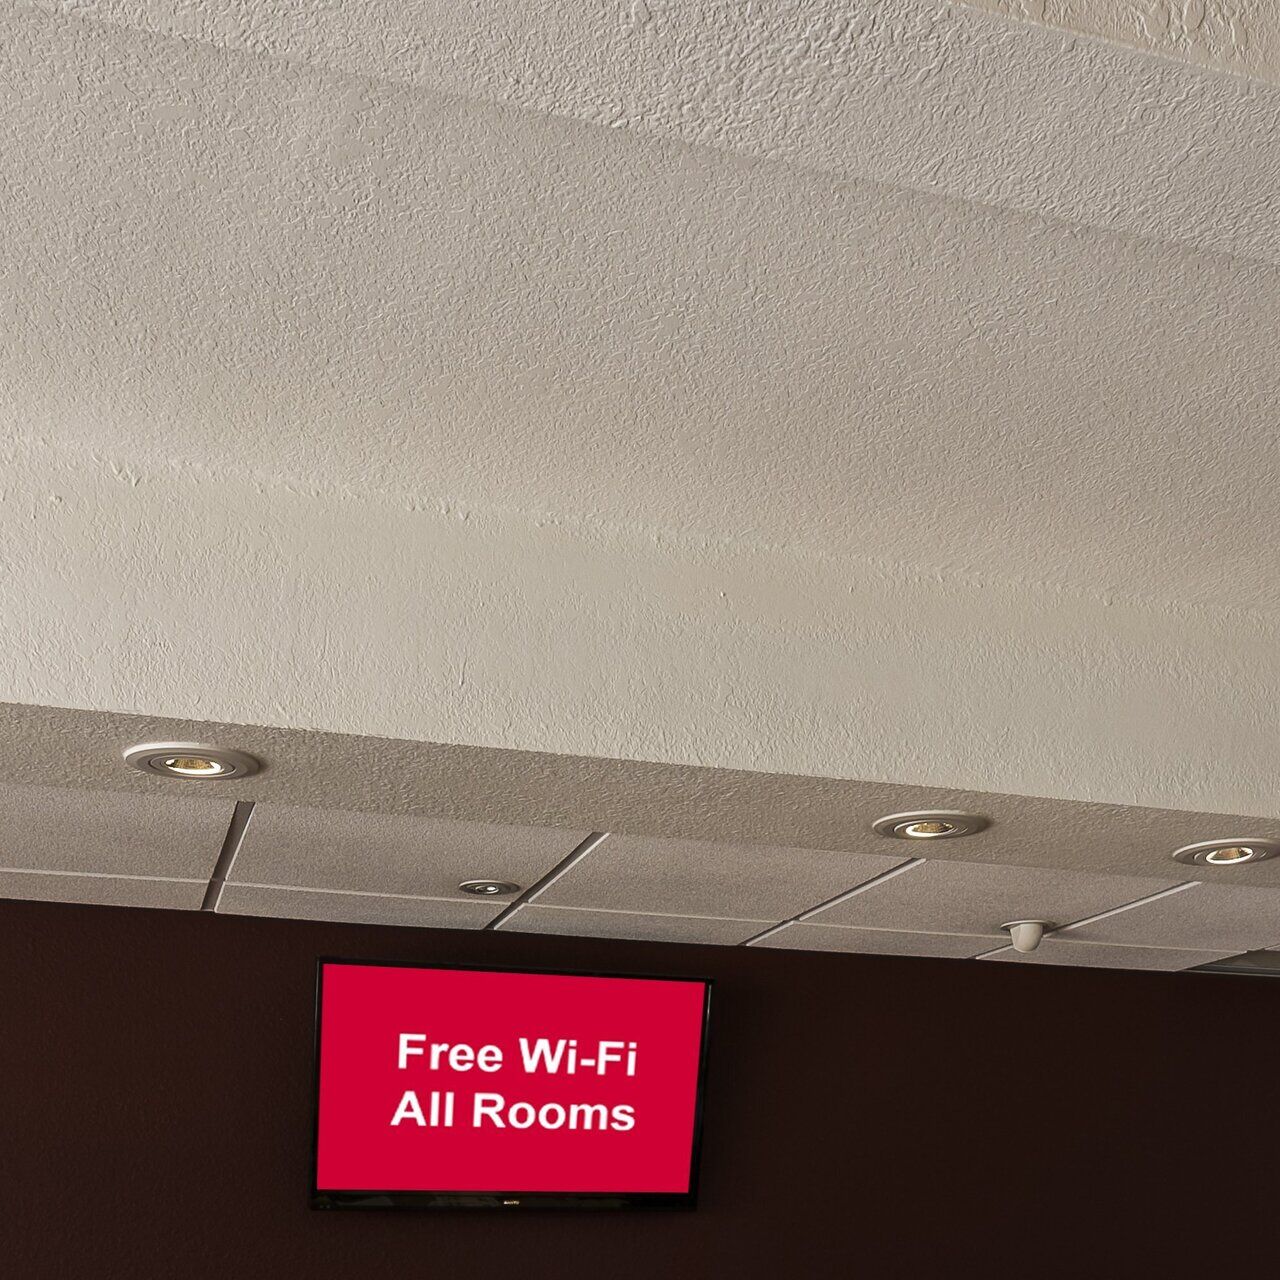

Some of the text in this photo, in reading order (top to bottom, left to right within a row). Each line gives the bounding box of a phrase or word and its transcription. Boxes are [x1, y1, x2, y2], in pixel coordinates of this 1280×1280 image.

[397, 1032, 638, 1077] Free Wi-Fi
[389, 1089, 636, 1132] All Rooms
